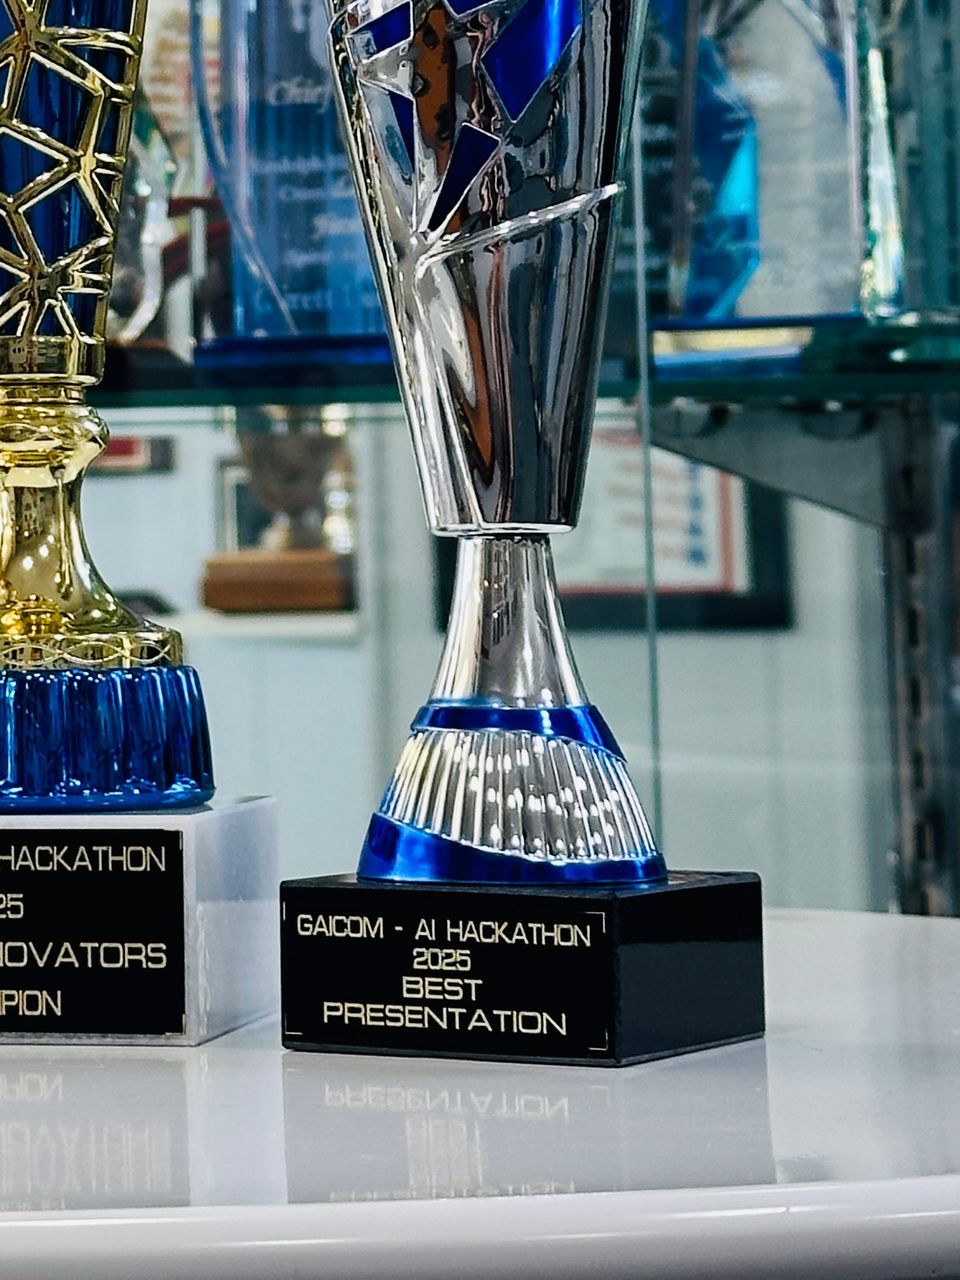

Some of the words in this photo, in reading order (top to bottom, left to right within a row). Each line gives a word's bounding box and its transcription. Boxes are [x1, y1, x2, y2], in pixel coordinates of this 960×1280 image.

[297, 913, 384, 939] GAICOM
[415, 919, 435, 941] AI
[446, 920, 591, 947] HACKATHON
[412, 948, 471, 971] 2025
[402, 976, 483, 1001] BEST
[323, 1001, 567, 1036] PRESENTATION
